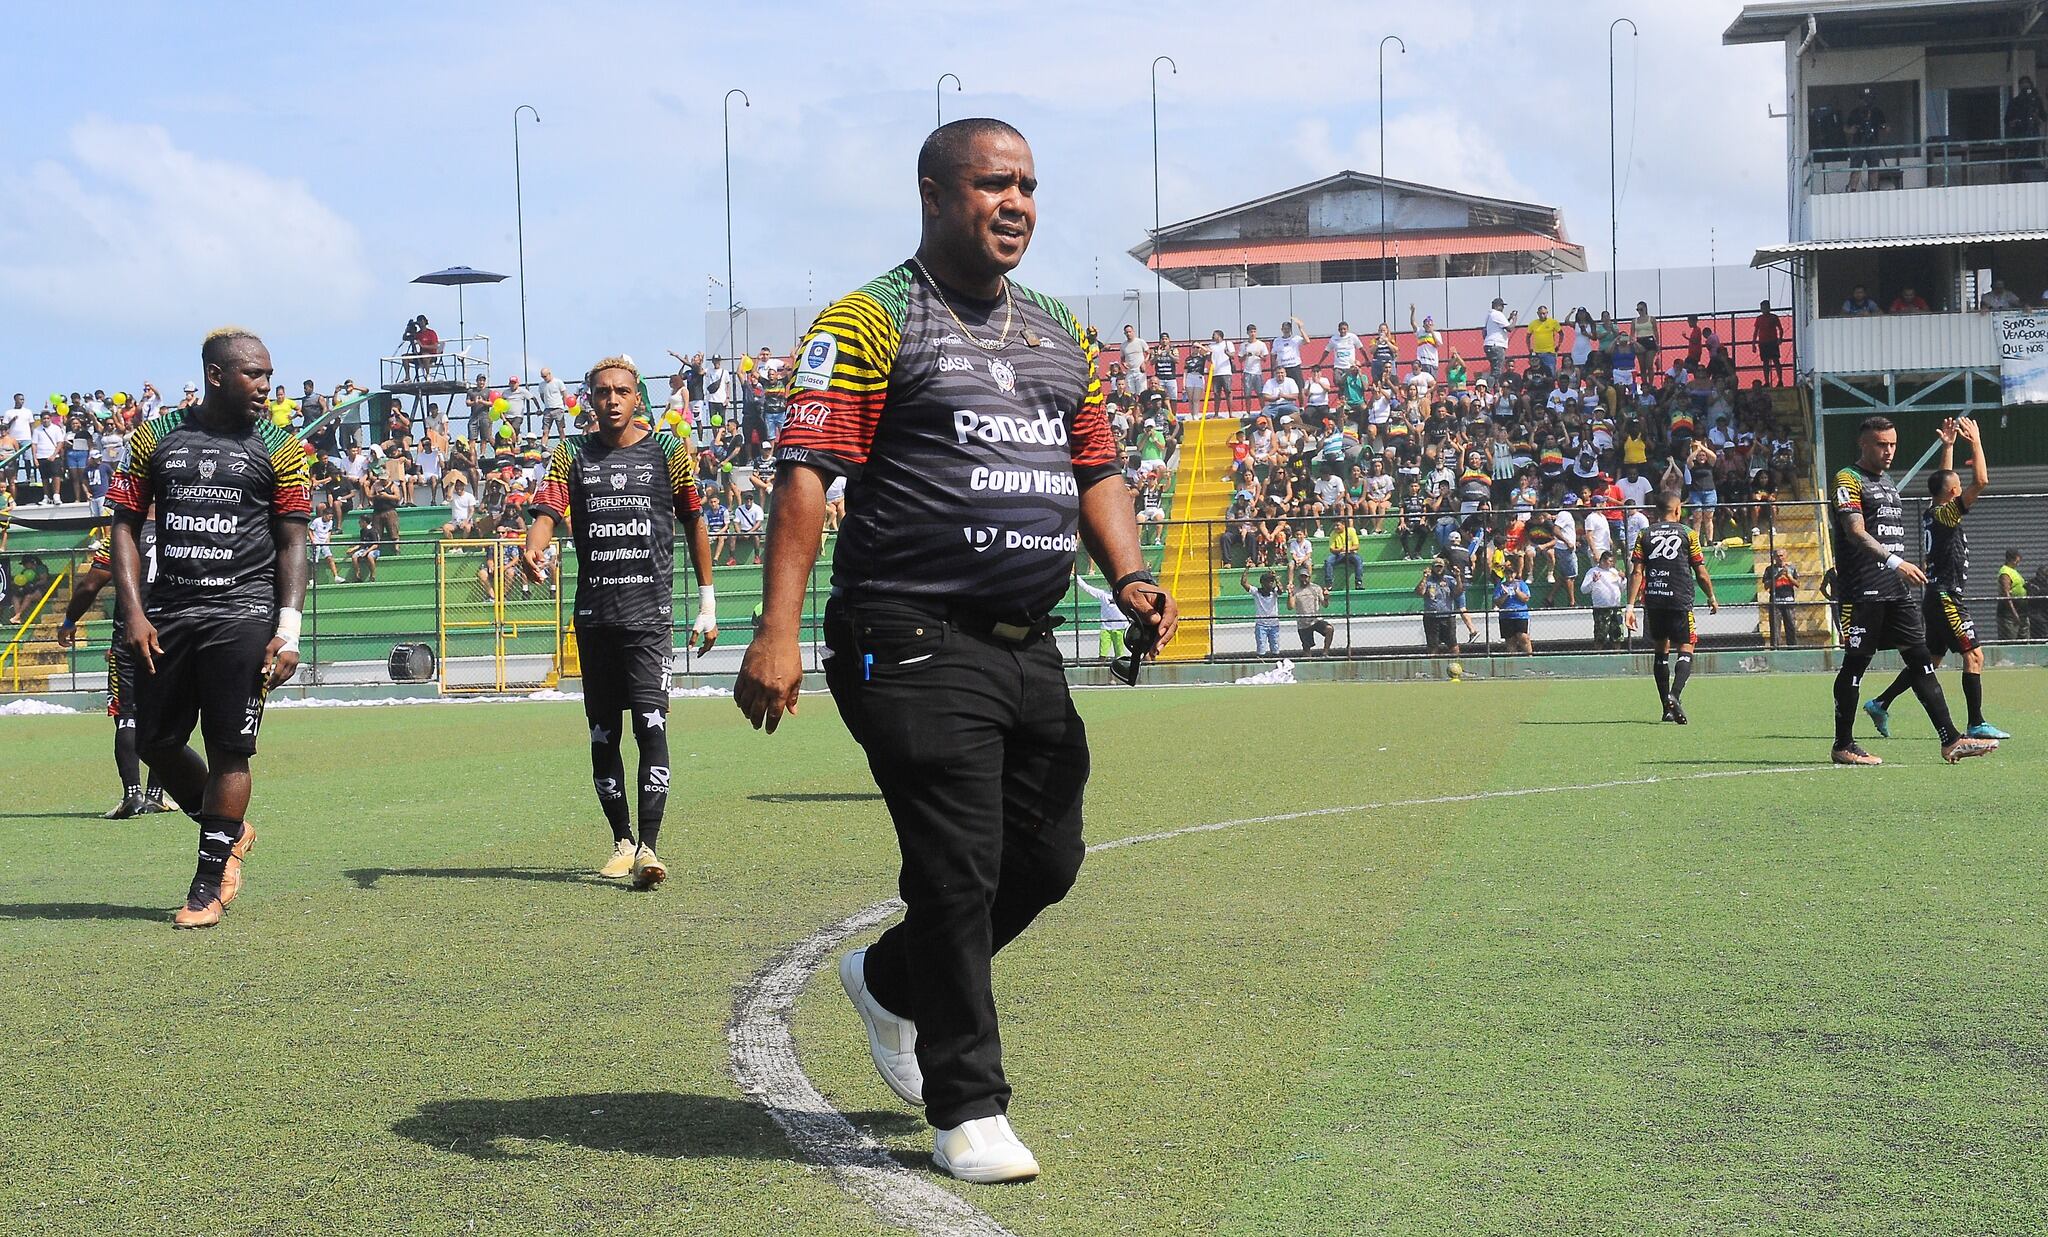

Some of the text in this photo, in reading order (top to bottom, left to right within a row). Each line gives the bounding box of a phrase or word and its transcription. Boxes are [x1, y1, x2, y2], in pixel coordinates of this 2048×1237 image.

[2003, 343, 2044, 355] QUE NOS
[939, 357, 974, 372] GASA
[953, 408, 1068, 446] Panado
[165, 460, 187, 469] GASA
[583, 476, 601, 485] GASA
[590, 498, 649, 509] PERFUMANIA
[588, 518, 652, 539] Panadol
[164, 544, 234, 560] CopyVision
[590, 547, 650, 562] CopyVision
[1648, 535, 1683, 560] 28
[602, 575, 655, 586] DoradoBet
[240, 715, 258, 736] 21
[644, 784, 670, 794] ROOT
